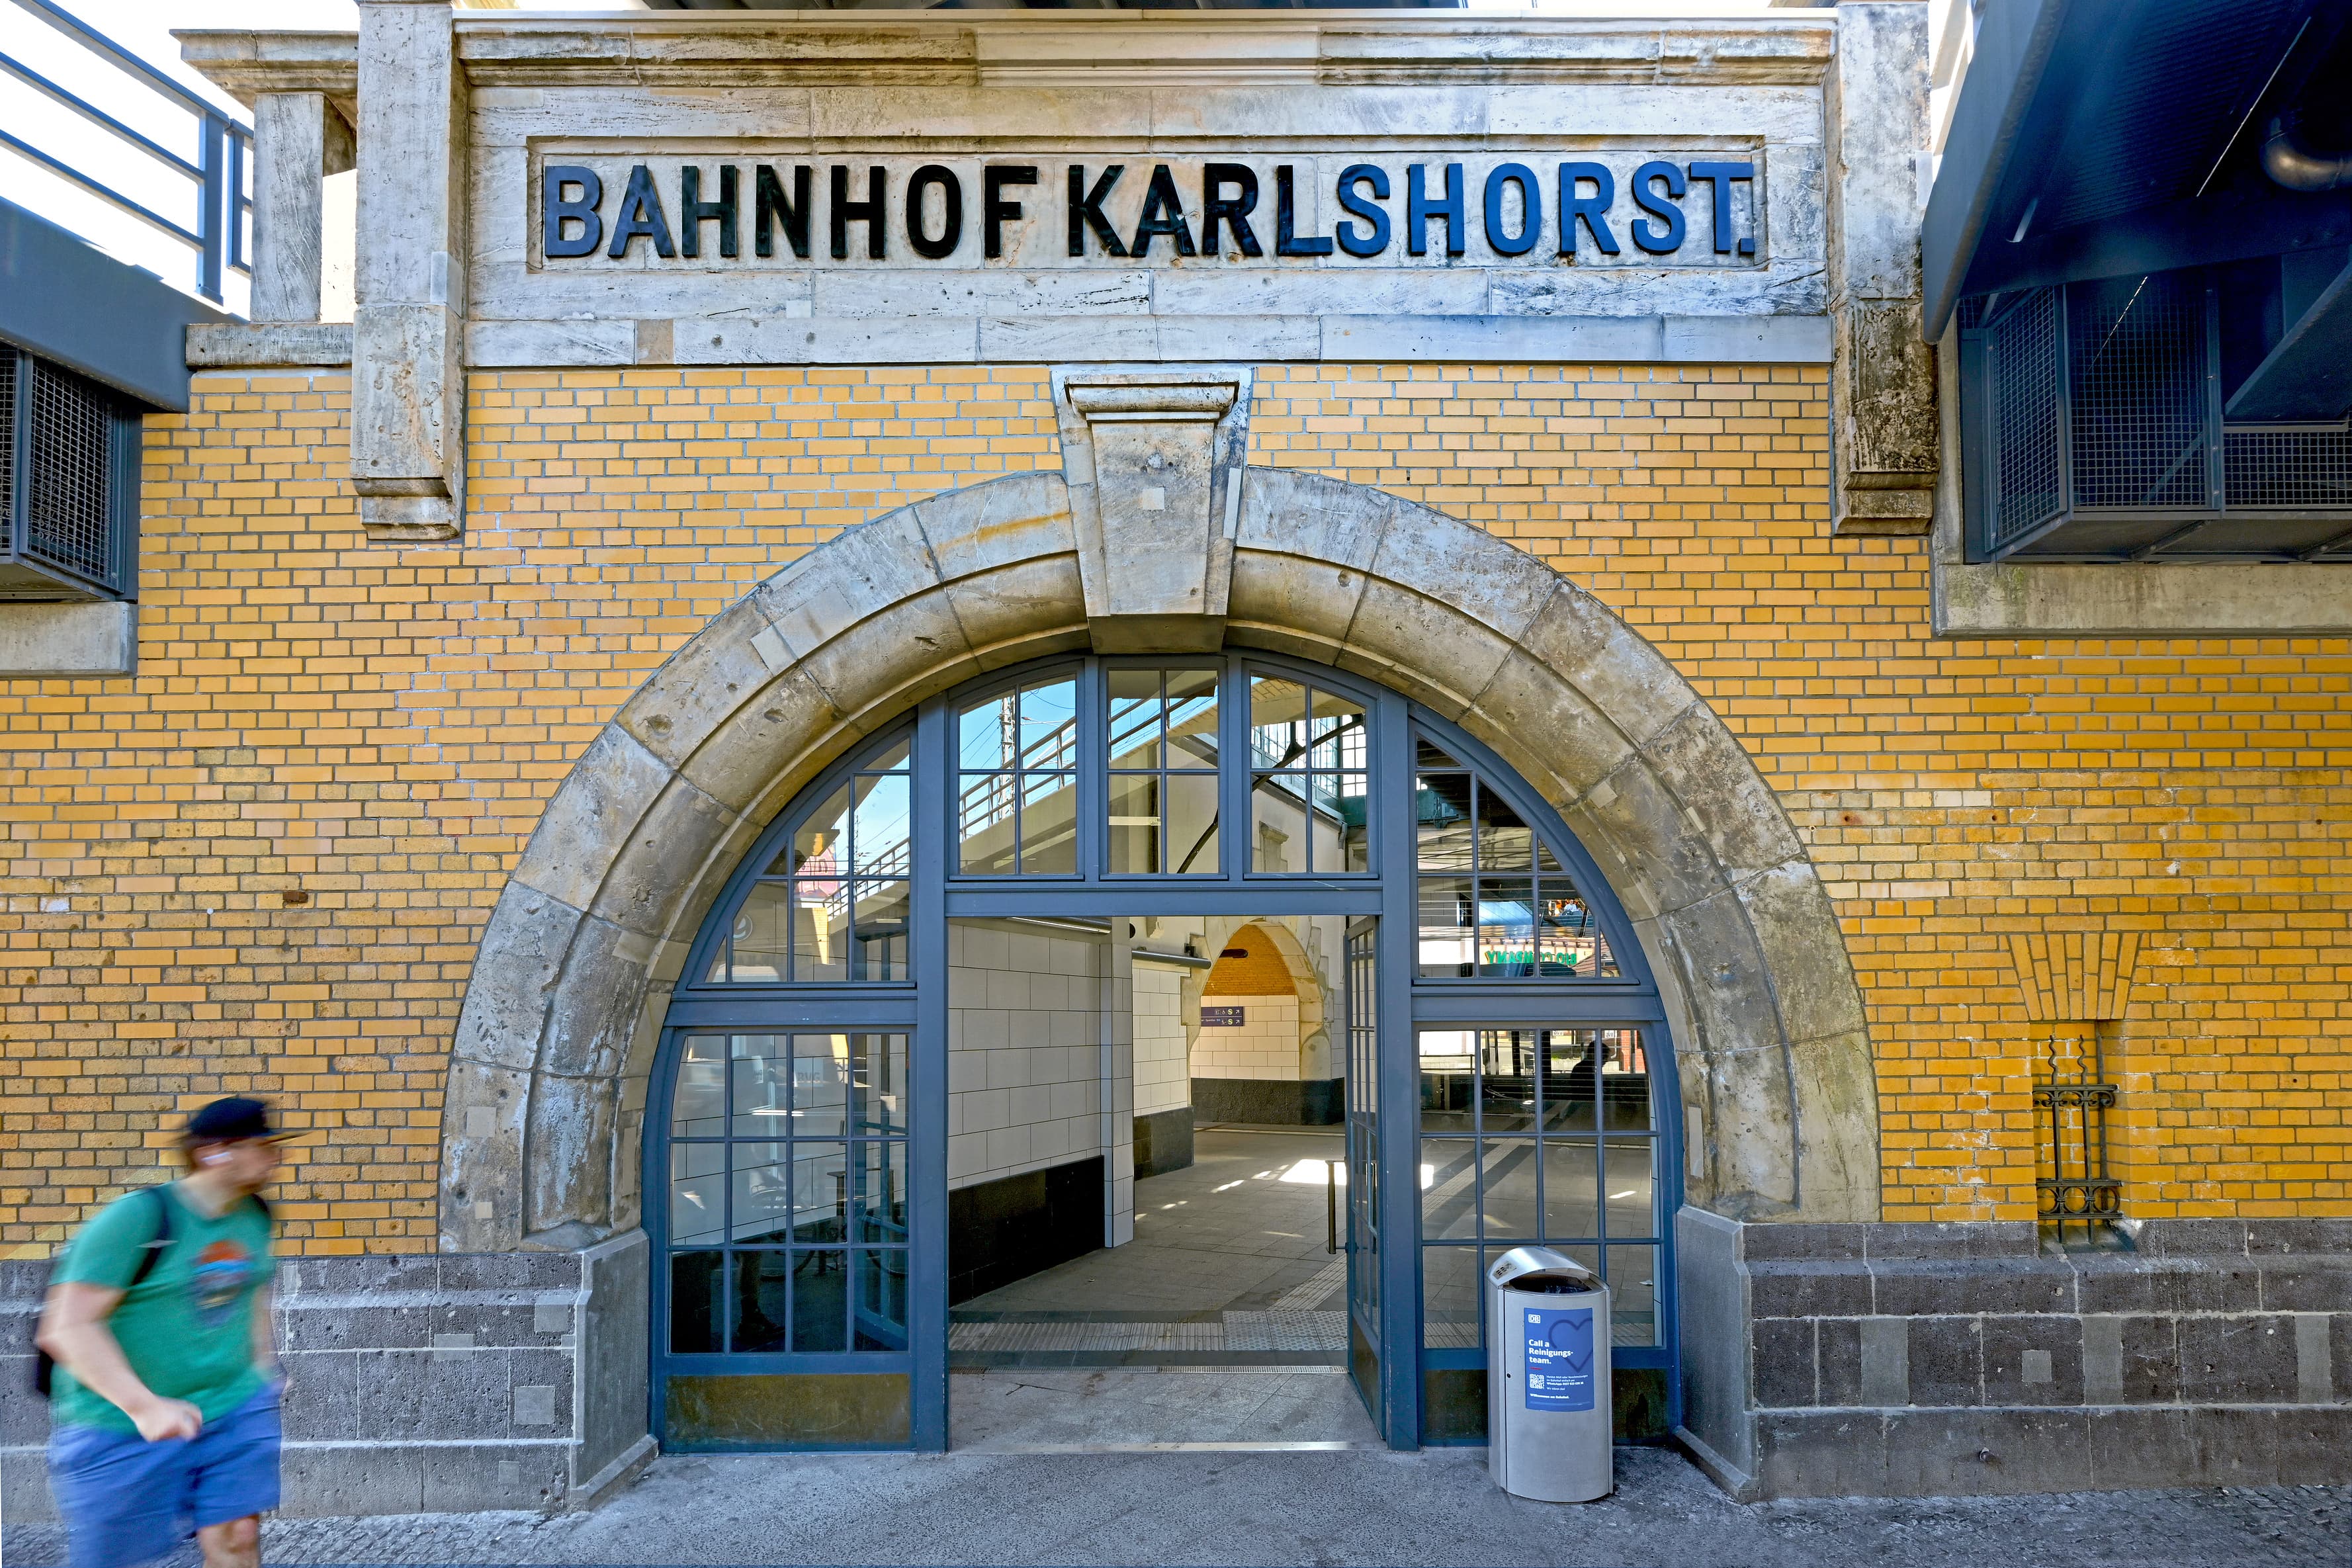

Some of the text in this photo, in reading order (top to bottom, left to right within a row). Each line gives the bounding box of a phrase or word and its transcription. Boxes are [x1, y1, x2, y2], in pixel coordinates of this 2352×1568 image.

[544, 161, 1755, 259] BAHNHOF KARLSHORST.
[1528, 1347, 1574, 1358] Reinigungs-
